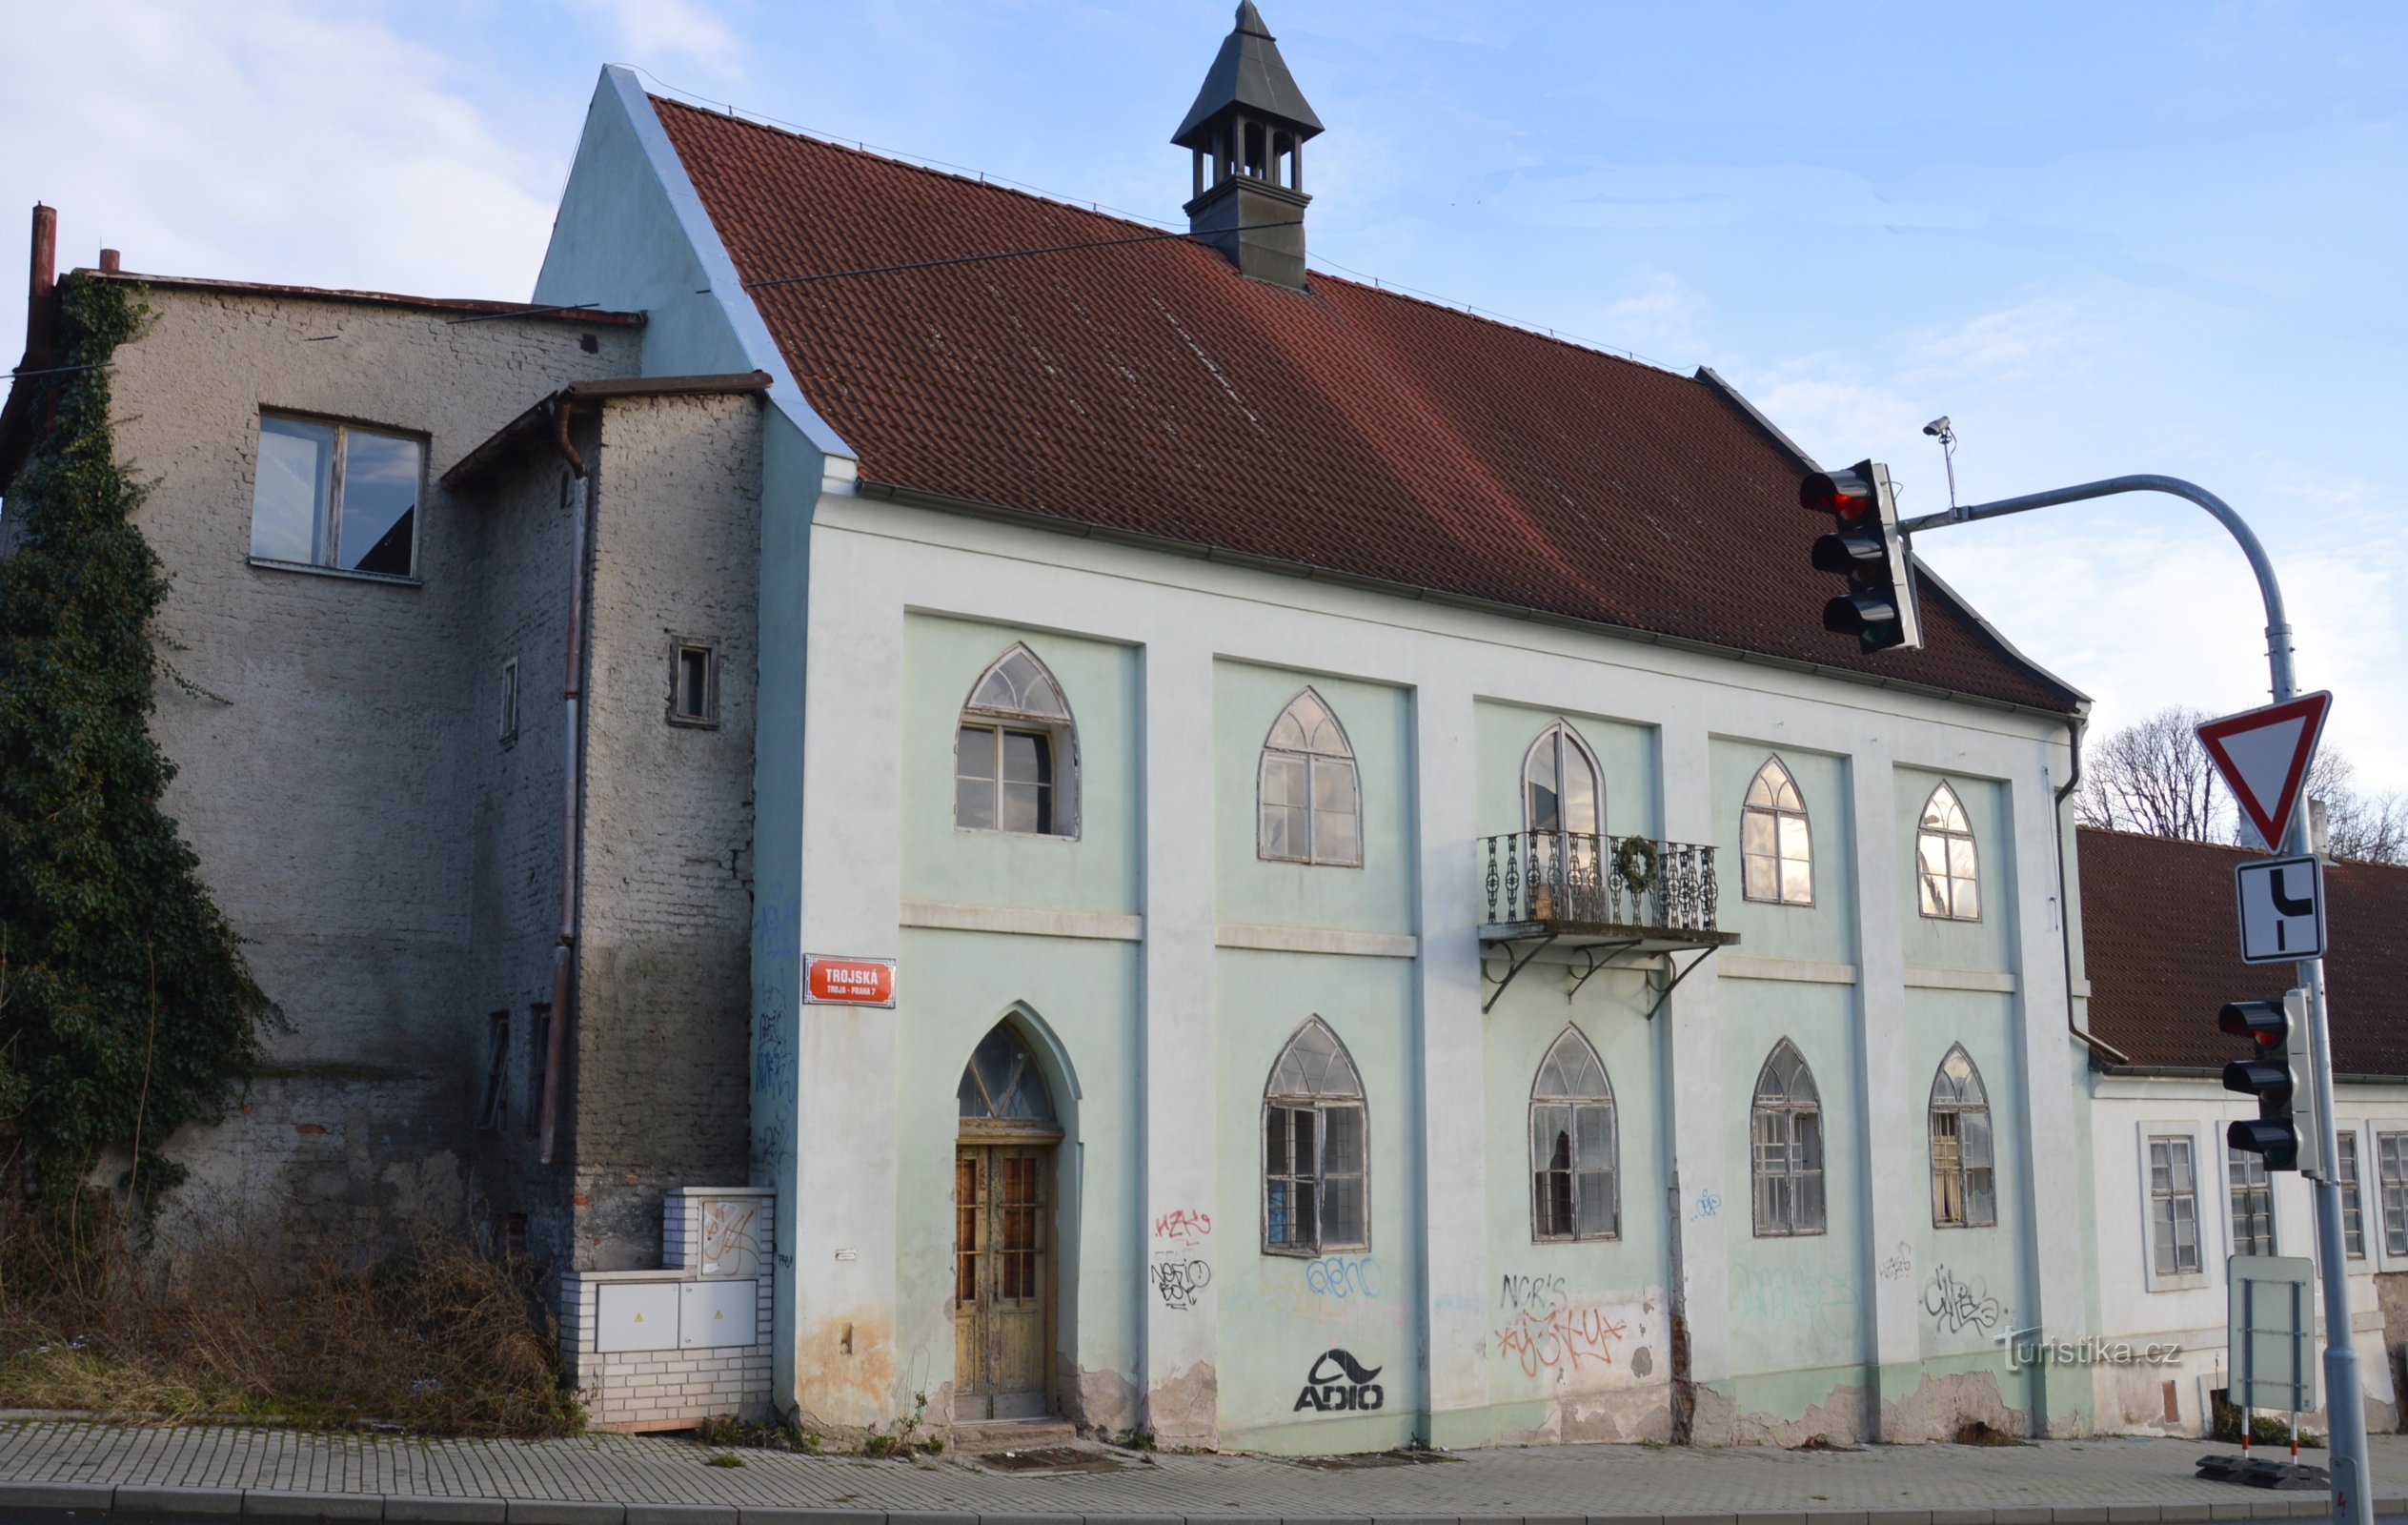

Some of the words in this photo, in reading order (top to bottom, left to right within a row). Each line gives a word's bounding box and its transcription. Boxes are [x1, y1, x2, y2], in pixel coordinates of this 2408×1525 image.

[825, 968, 879, 985] TROJSKÁ
[827, 985, 846, 994] TROJA
[851, 986, 871, 996] PRAHA
[871, 987, 877, 996] 7
[1293, 1384, 1384, 1413] ADIO
